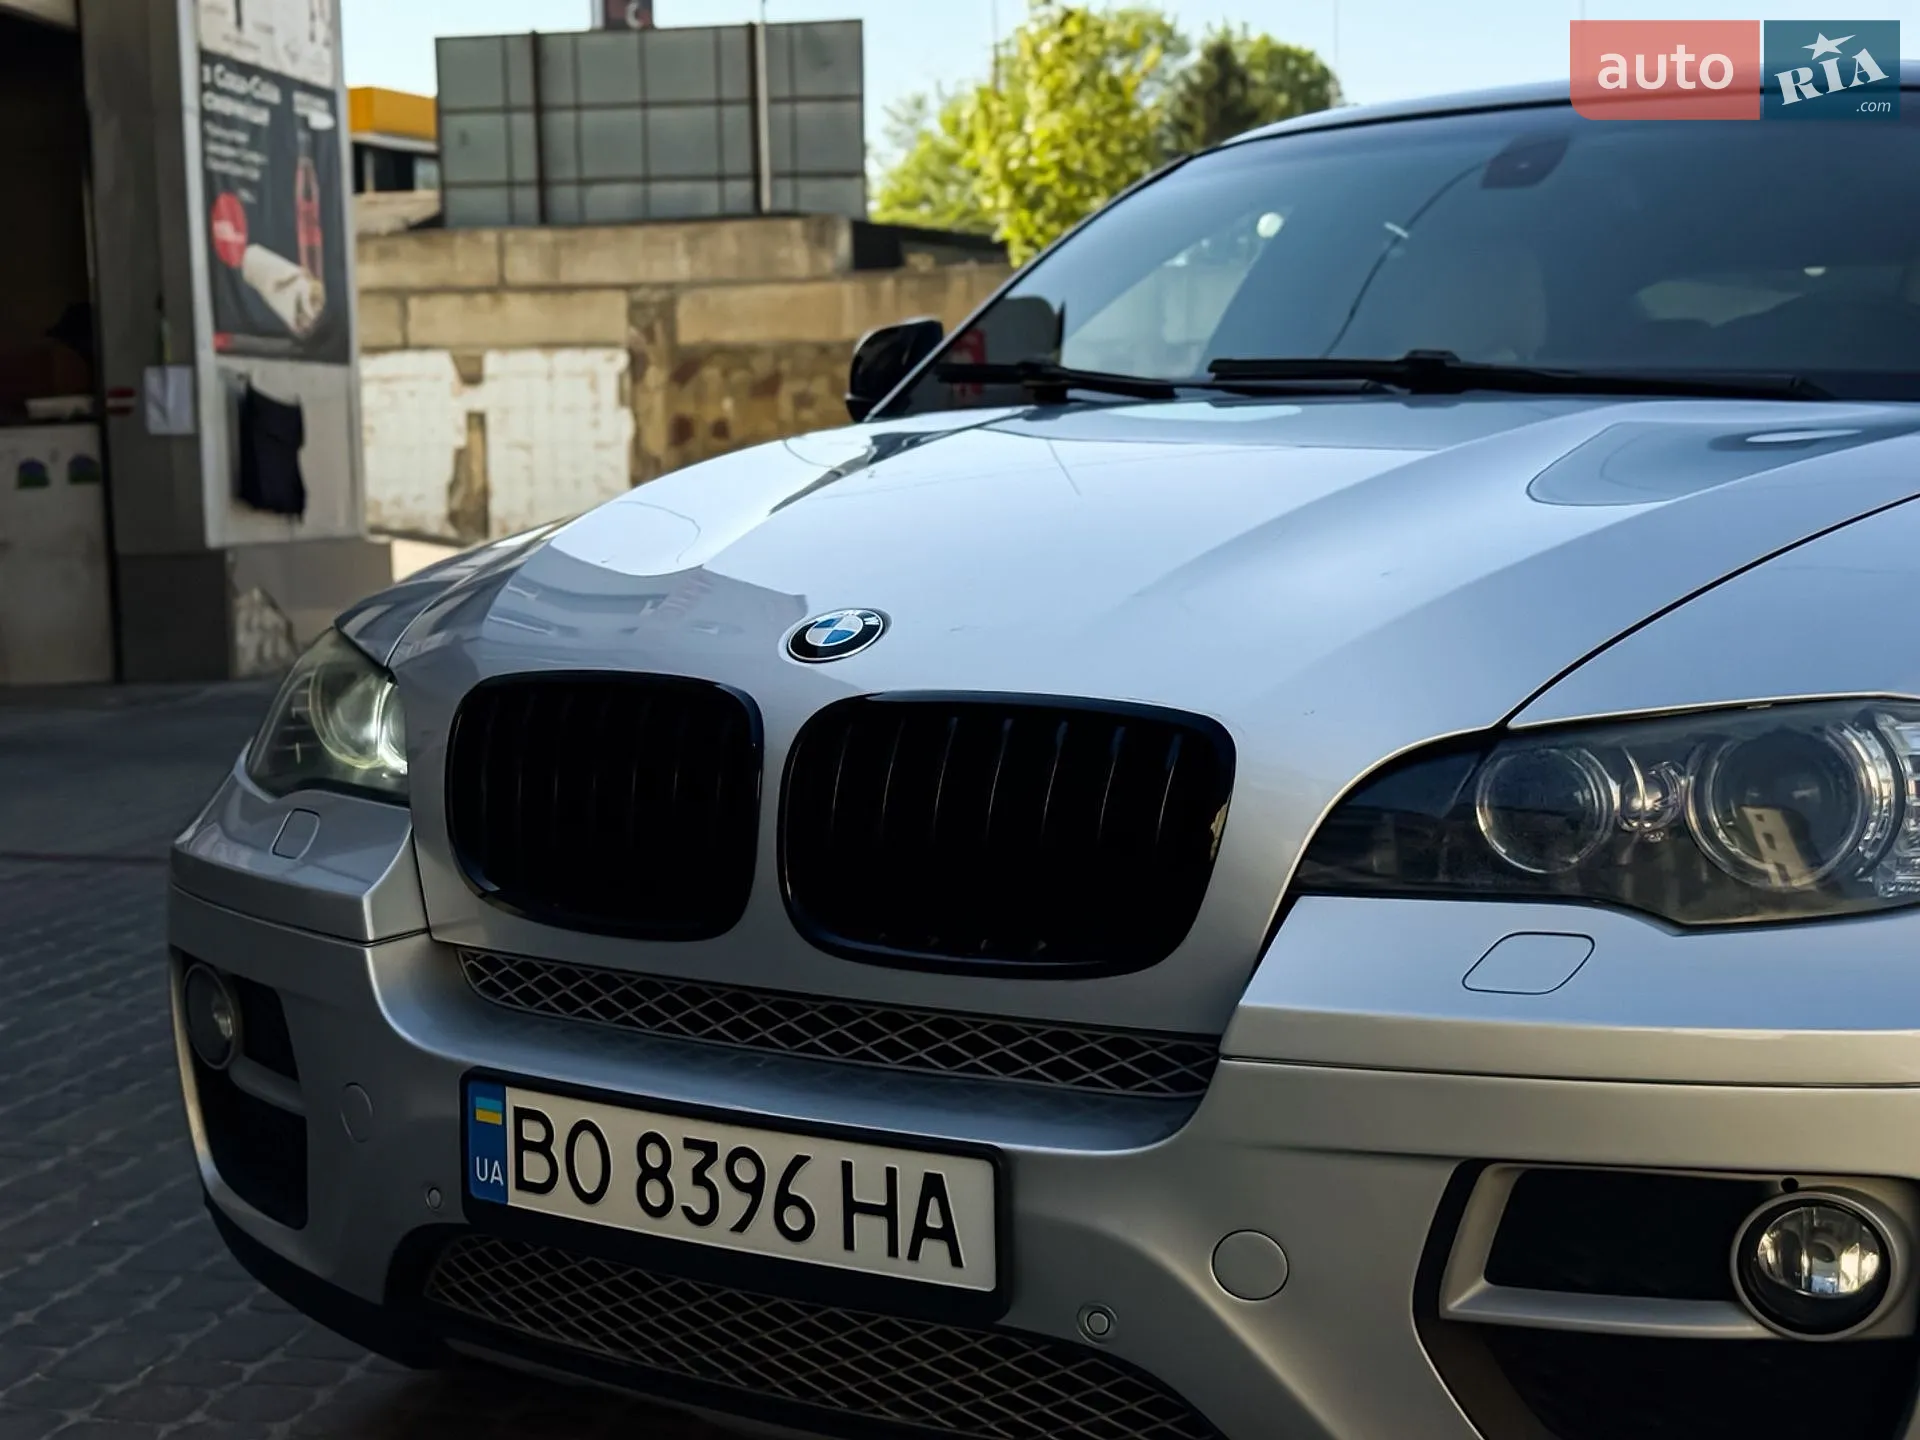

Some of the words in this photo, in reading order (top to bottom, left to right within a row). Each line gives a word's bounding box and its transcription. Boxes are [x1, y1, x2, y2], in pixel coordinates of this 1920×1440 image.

[476, 1156, 504, 1186] UA
[514, 1106, 612, 1205] BO
[636, 1131, 817, 1243] 8396
[841, 1160, 964, 1269] HA
